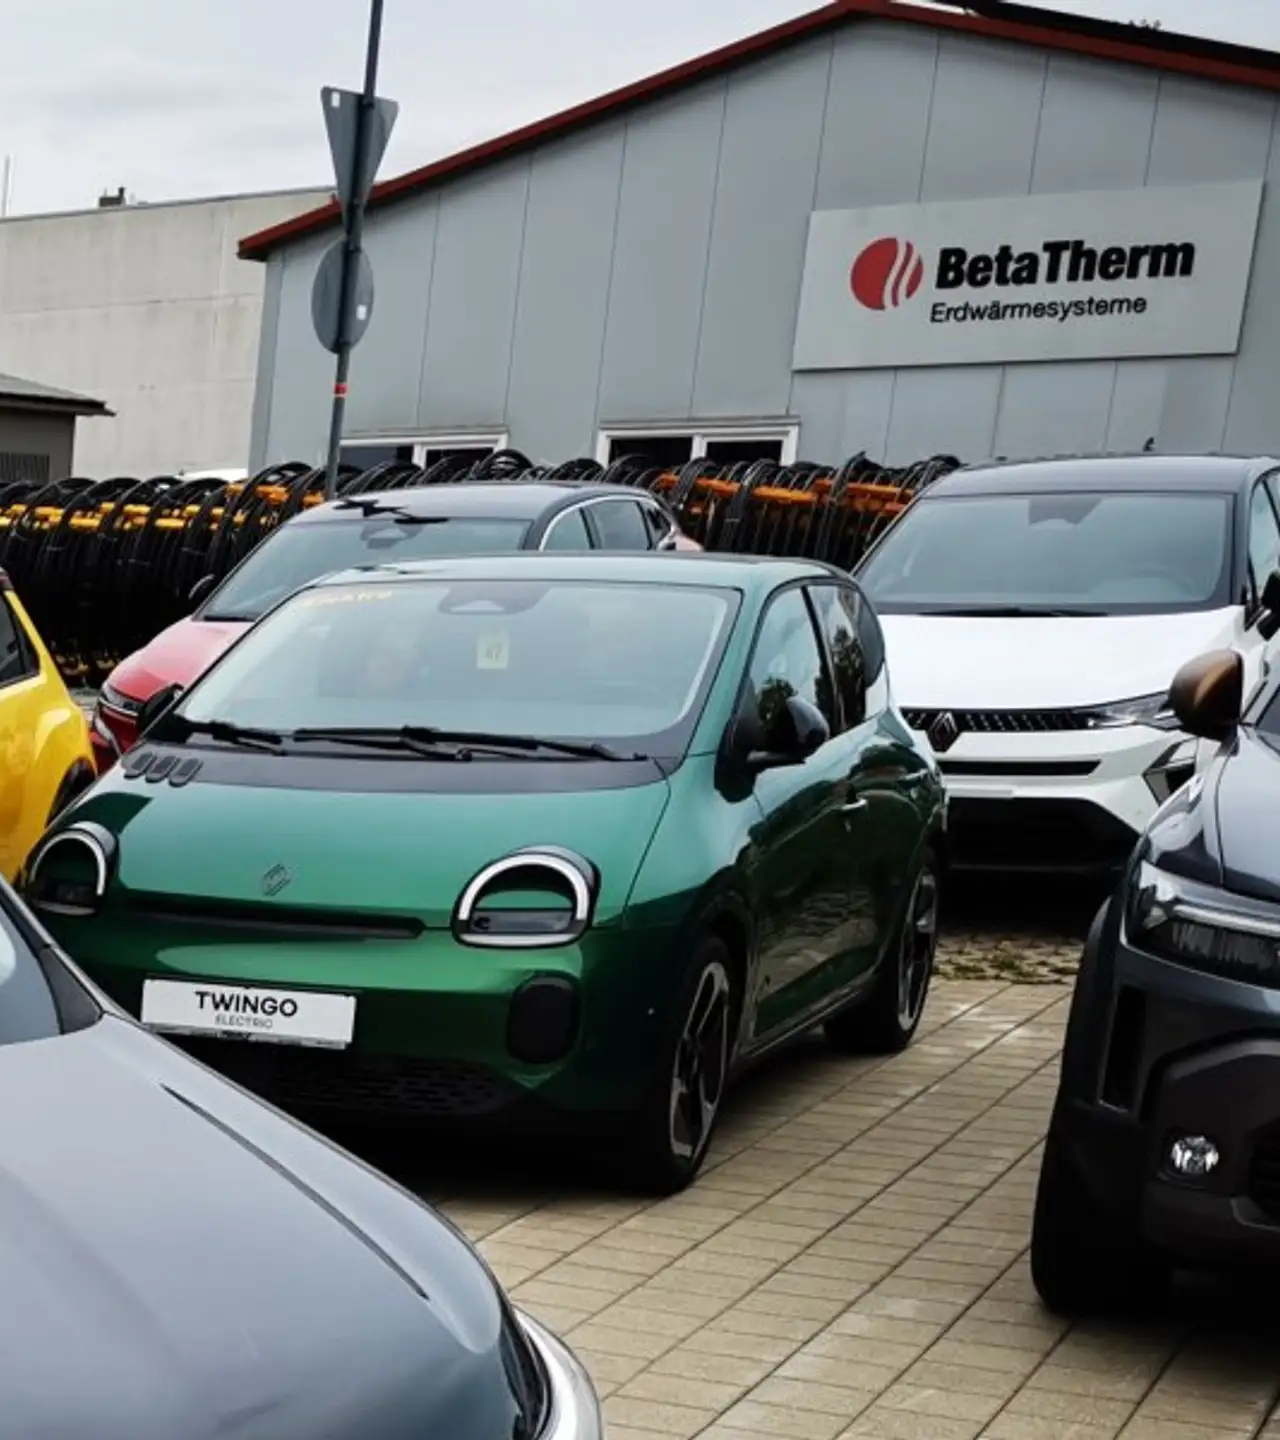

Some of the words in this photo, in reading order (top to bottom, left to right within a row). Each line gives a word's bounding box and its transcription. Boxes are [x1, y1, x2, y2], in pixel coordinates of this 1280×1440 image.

[935, 240, 1195, 289] BetaTherm
[930, 295, 1147, 323] Erdwärmesysteme
[195, 991, 298, 1017] TWINGO
